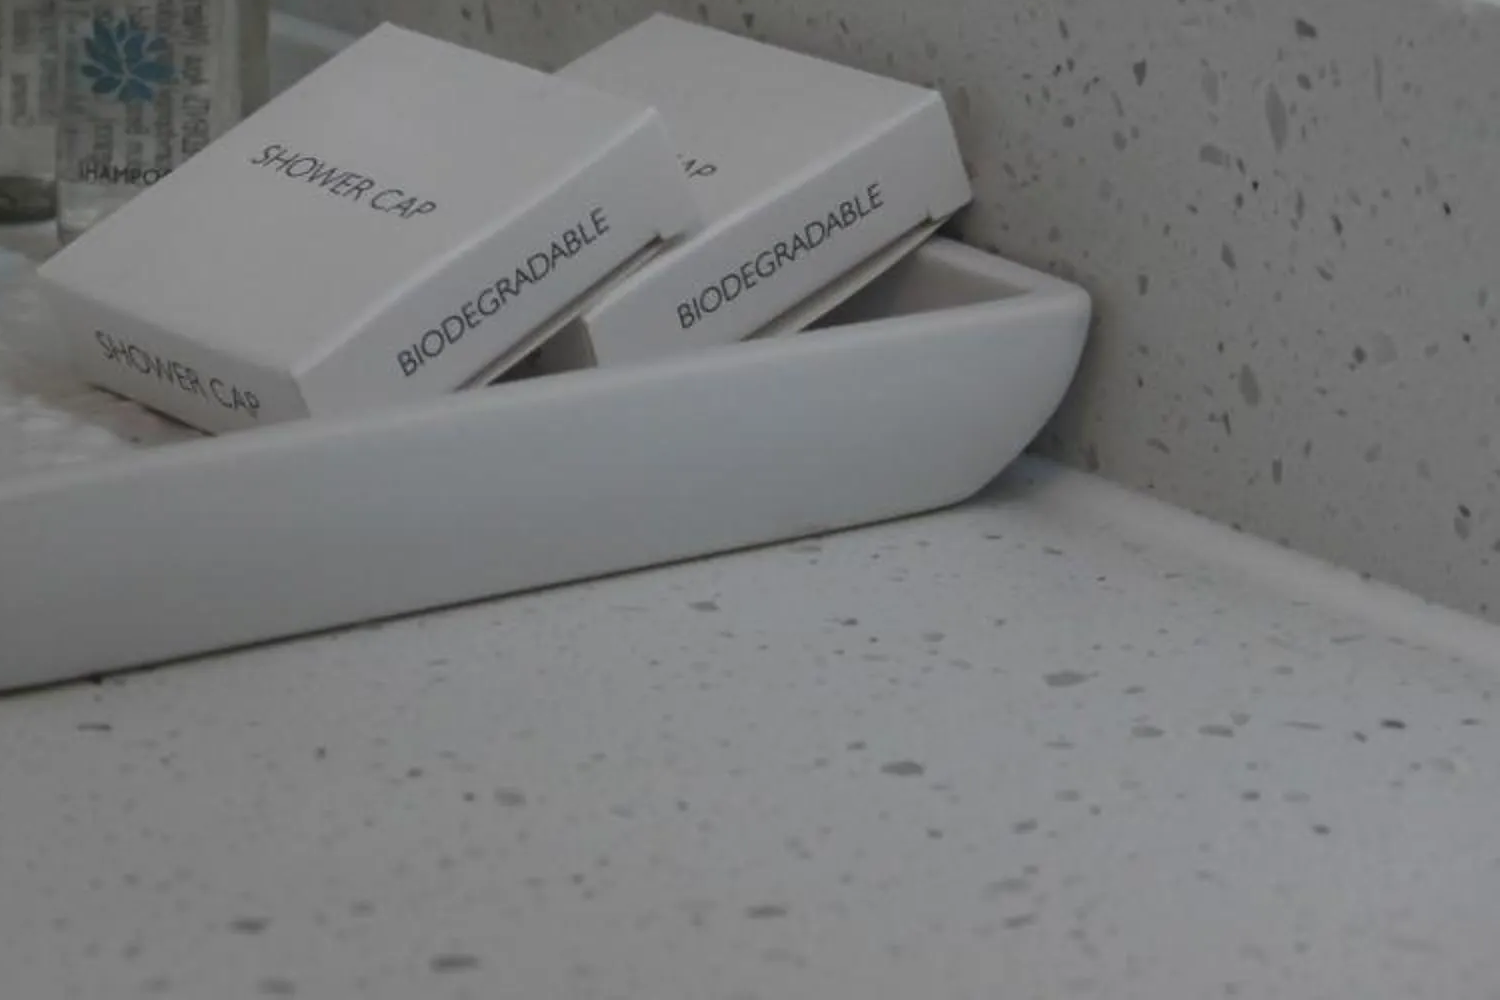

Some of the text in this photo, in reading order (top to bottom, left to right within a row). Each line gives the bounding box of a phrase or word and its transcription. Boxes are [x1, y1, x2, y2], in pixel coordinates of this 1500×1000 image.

[249, 144, 437, 219] SHOWER CAP
[395, 207, 611, 378] BIODEGRADABLE
[676, 182, 885, 330] BIODEGRADABLE
[94, 329, 261, 419] SHOWER CAP
